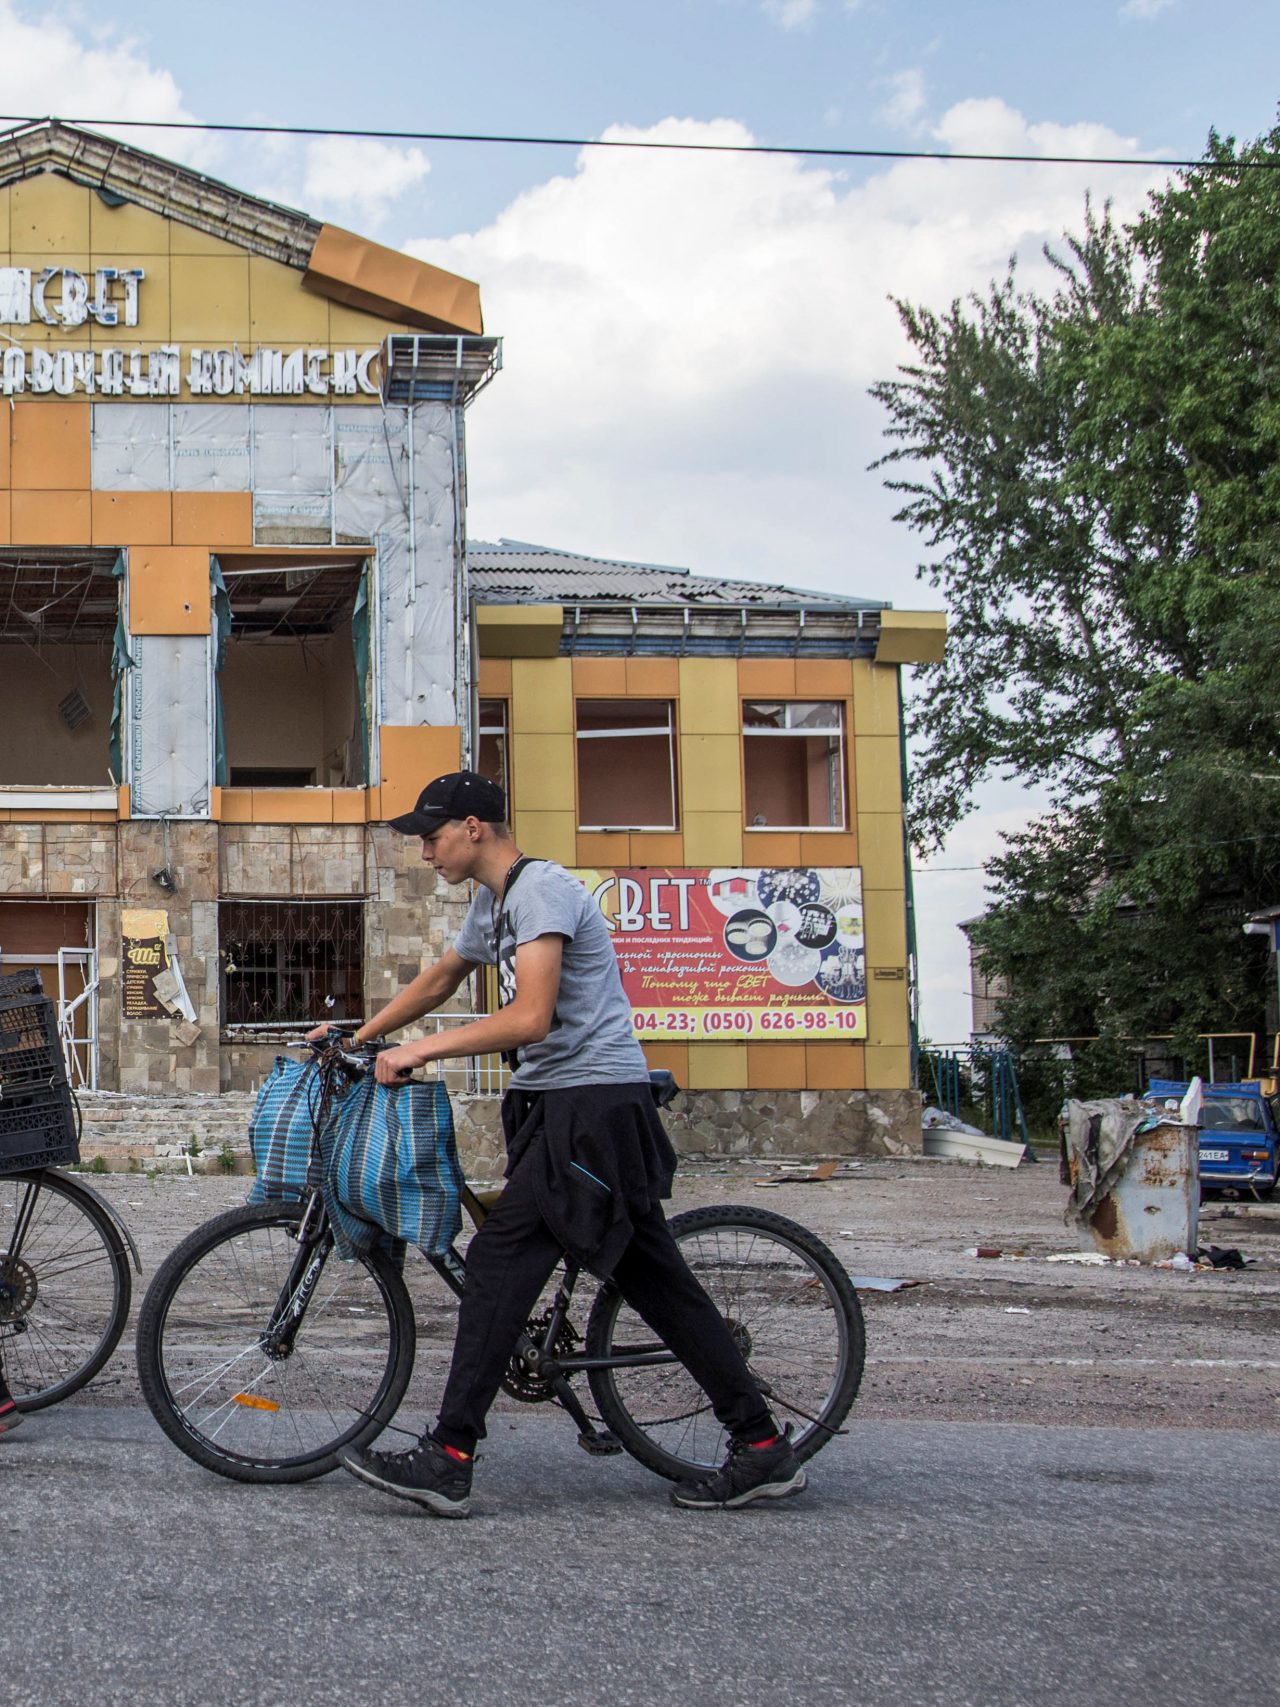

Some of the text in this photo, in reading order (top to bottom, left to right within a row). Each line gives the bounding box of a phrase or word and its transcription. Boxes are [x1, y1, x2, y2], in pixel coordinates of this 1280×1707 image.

[32, 266, 145, 328] СВЕТ
[592, 877, 697, 932] СВЕТ
[642, 976, 699, 993] Потому
[736, 974, 772, 989] СВЕТ
[703, 1012, 754, 1033] (050)
[760, 1011, 857, 1030] 626-98-10
